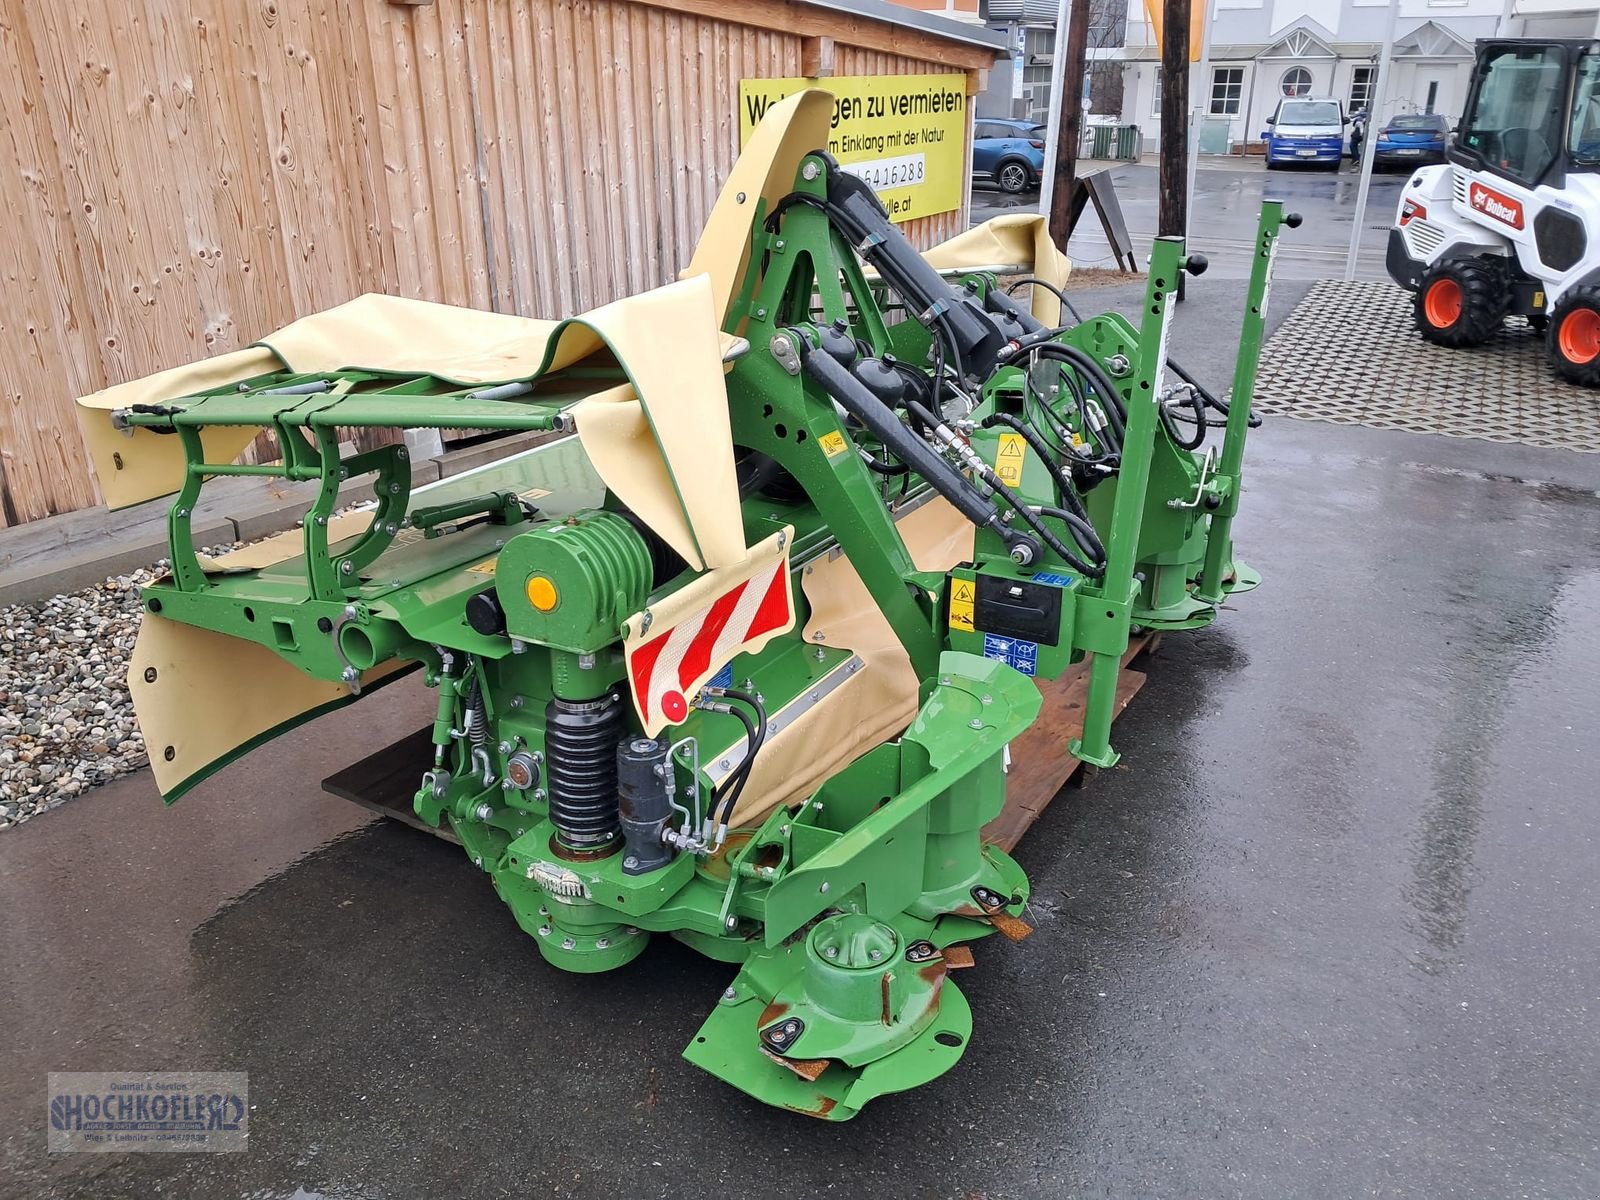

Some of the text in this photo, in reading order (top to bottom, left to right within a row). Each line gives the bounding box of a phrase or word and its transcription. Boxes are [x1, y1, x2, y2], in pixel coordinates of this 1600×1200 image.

[867, 96, 885, 118] zu
[890, 87, 962, 116] vermieten
[842, 134, 884, 153] Einklang
[887, 131, 902, 147] mit
[904, 130, 919, 145] der
[922, 127, 945, 144] Natur
[1485, 197, 1517, 223] Bobcat
